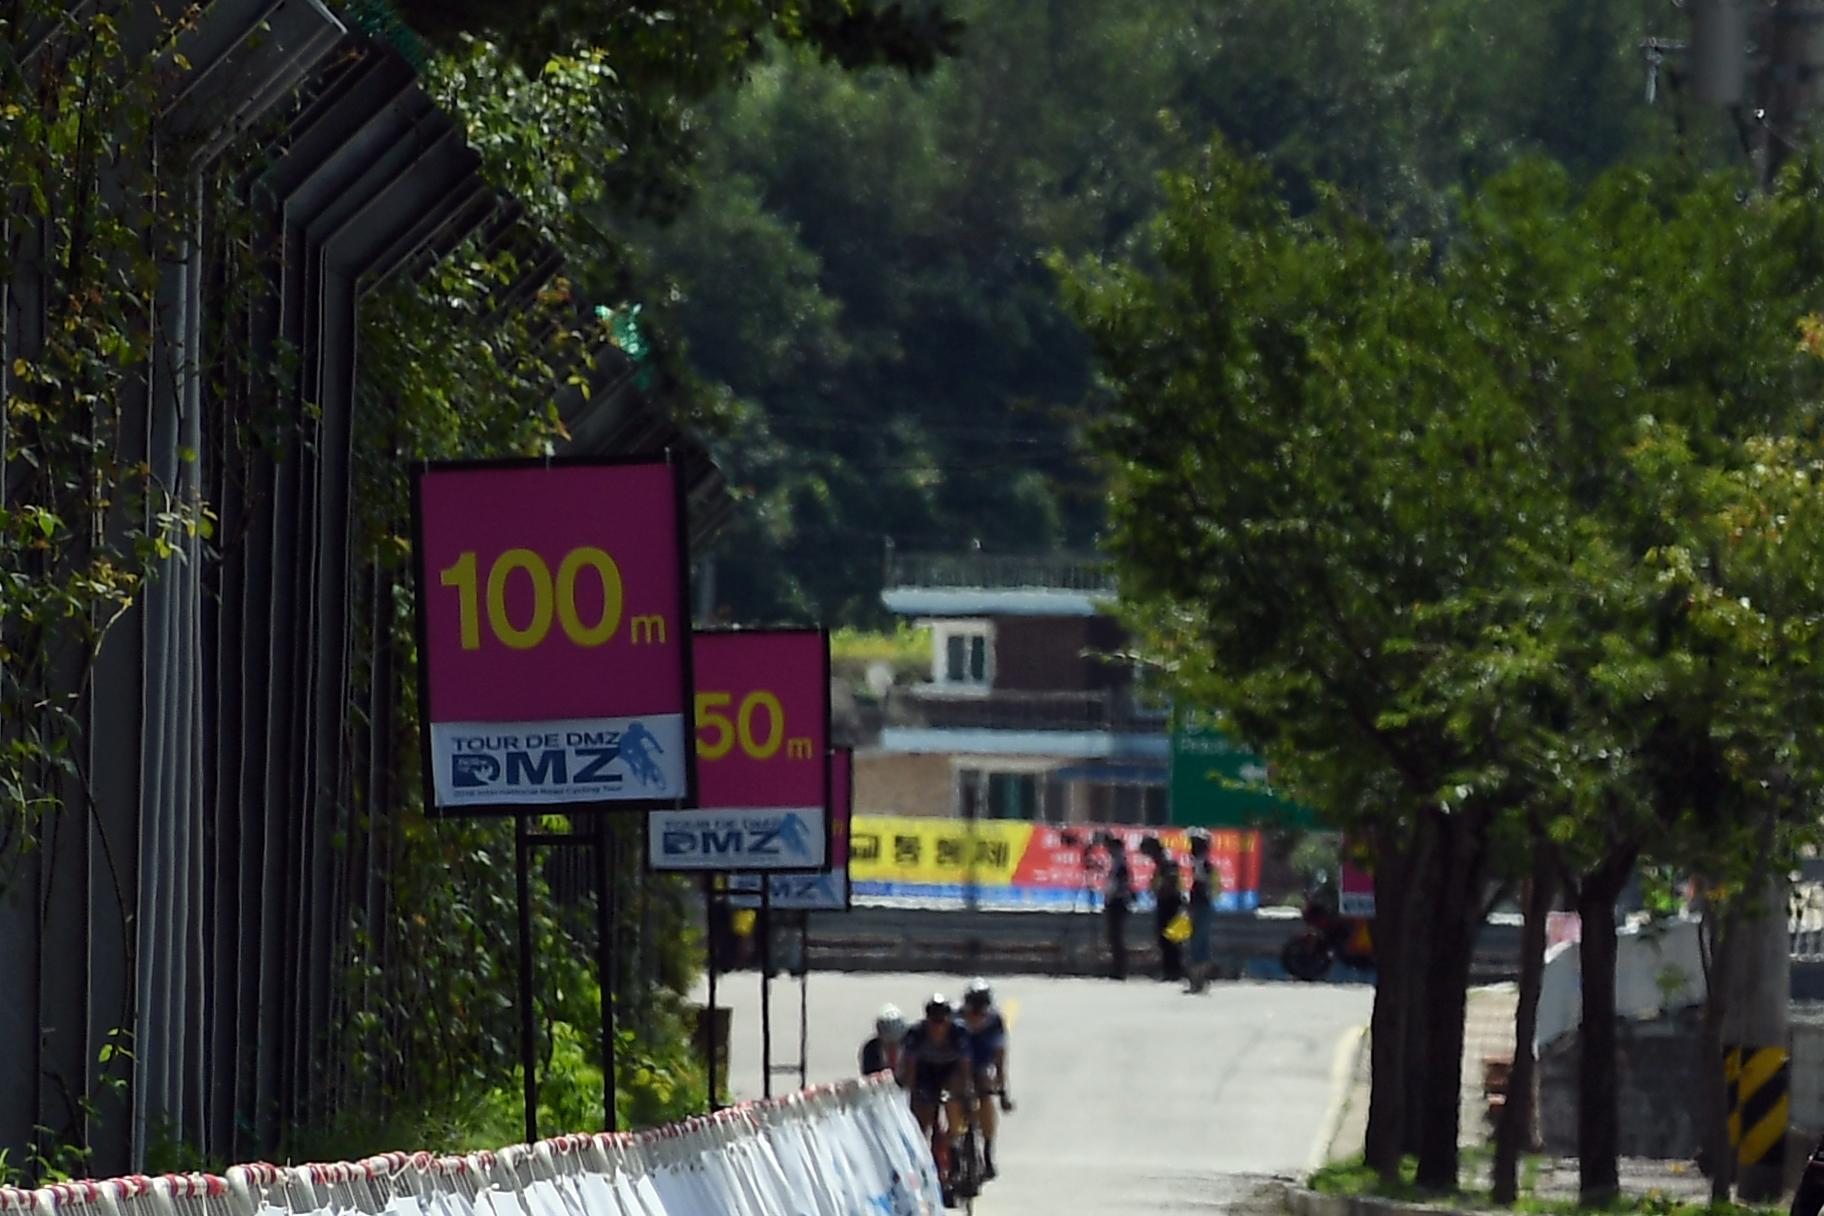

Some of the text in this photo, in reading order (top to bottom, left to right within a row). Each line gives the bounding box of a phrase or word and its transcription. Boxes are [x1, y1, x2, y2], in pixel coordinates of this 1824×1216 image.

[452, 731, 621, 751] TOUR DE DMZ
[694, 691, 813, 761] 50m
[452, 747, 624, 788] DMZ
[662, 830, 780, 855] DMZ
